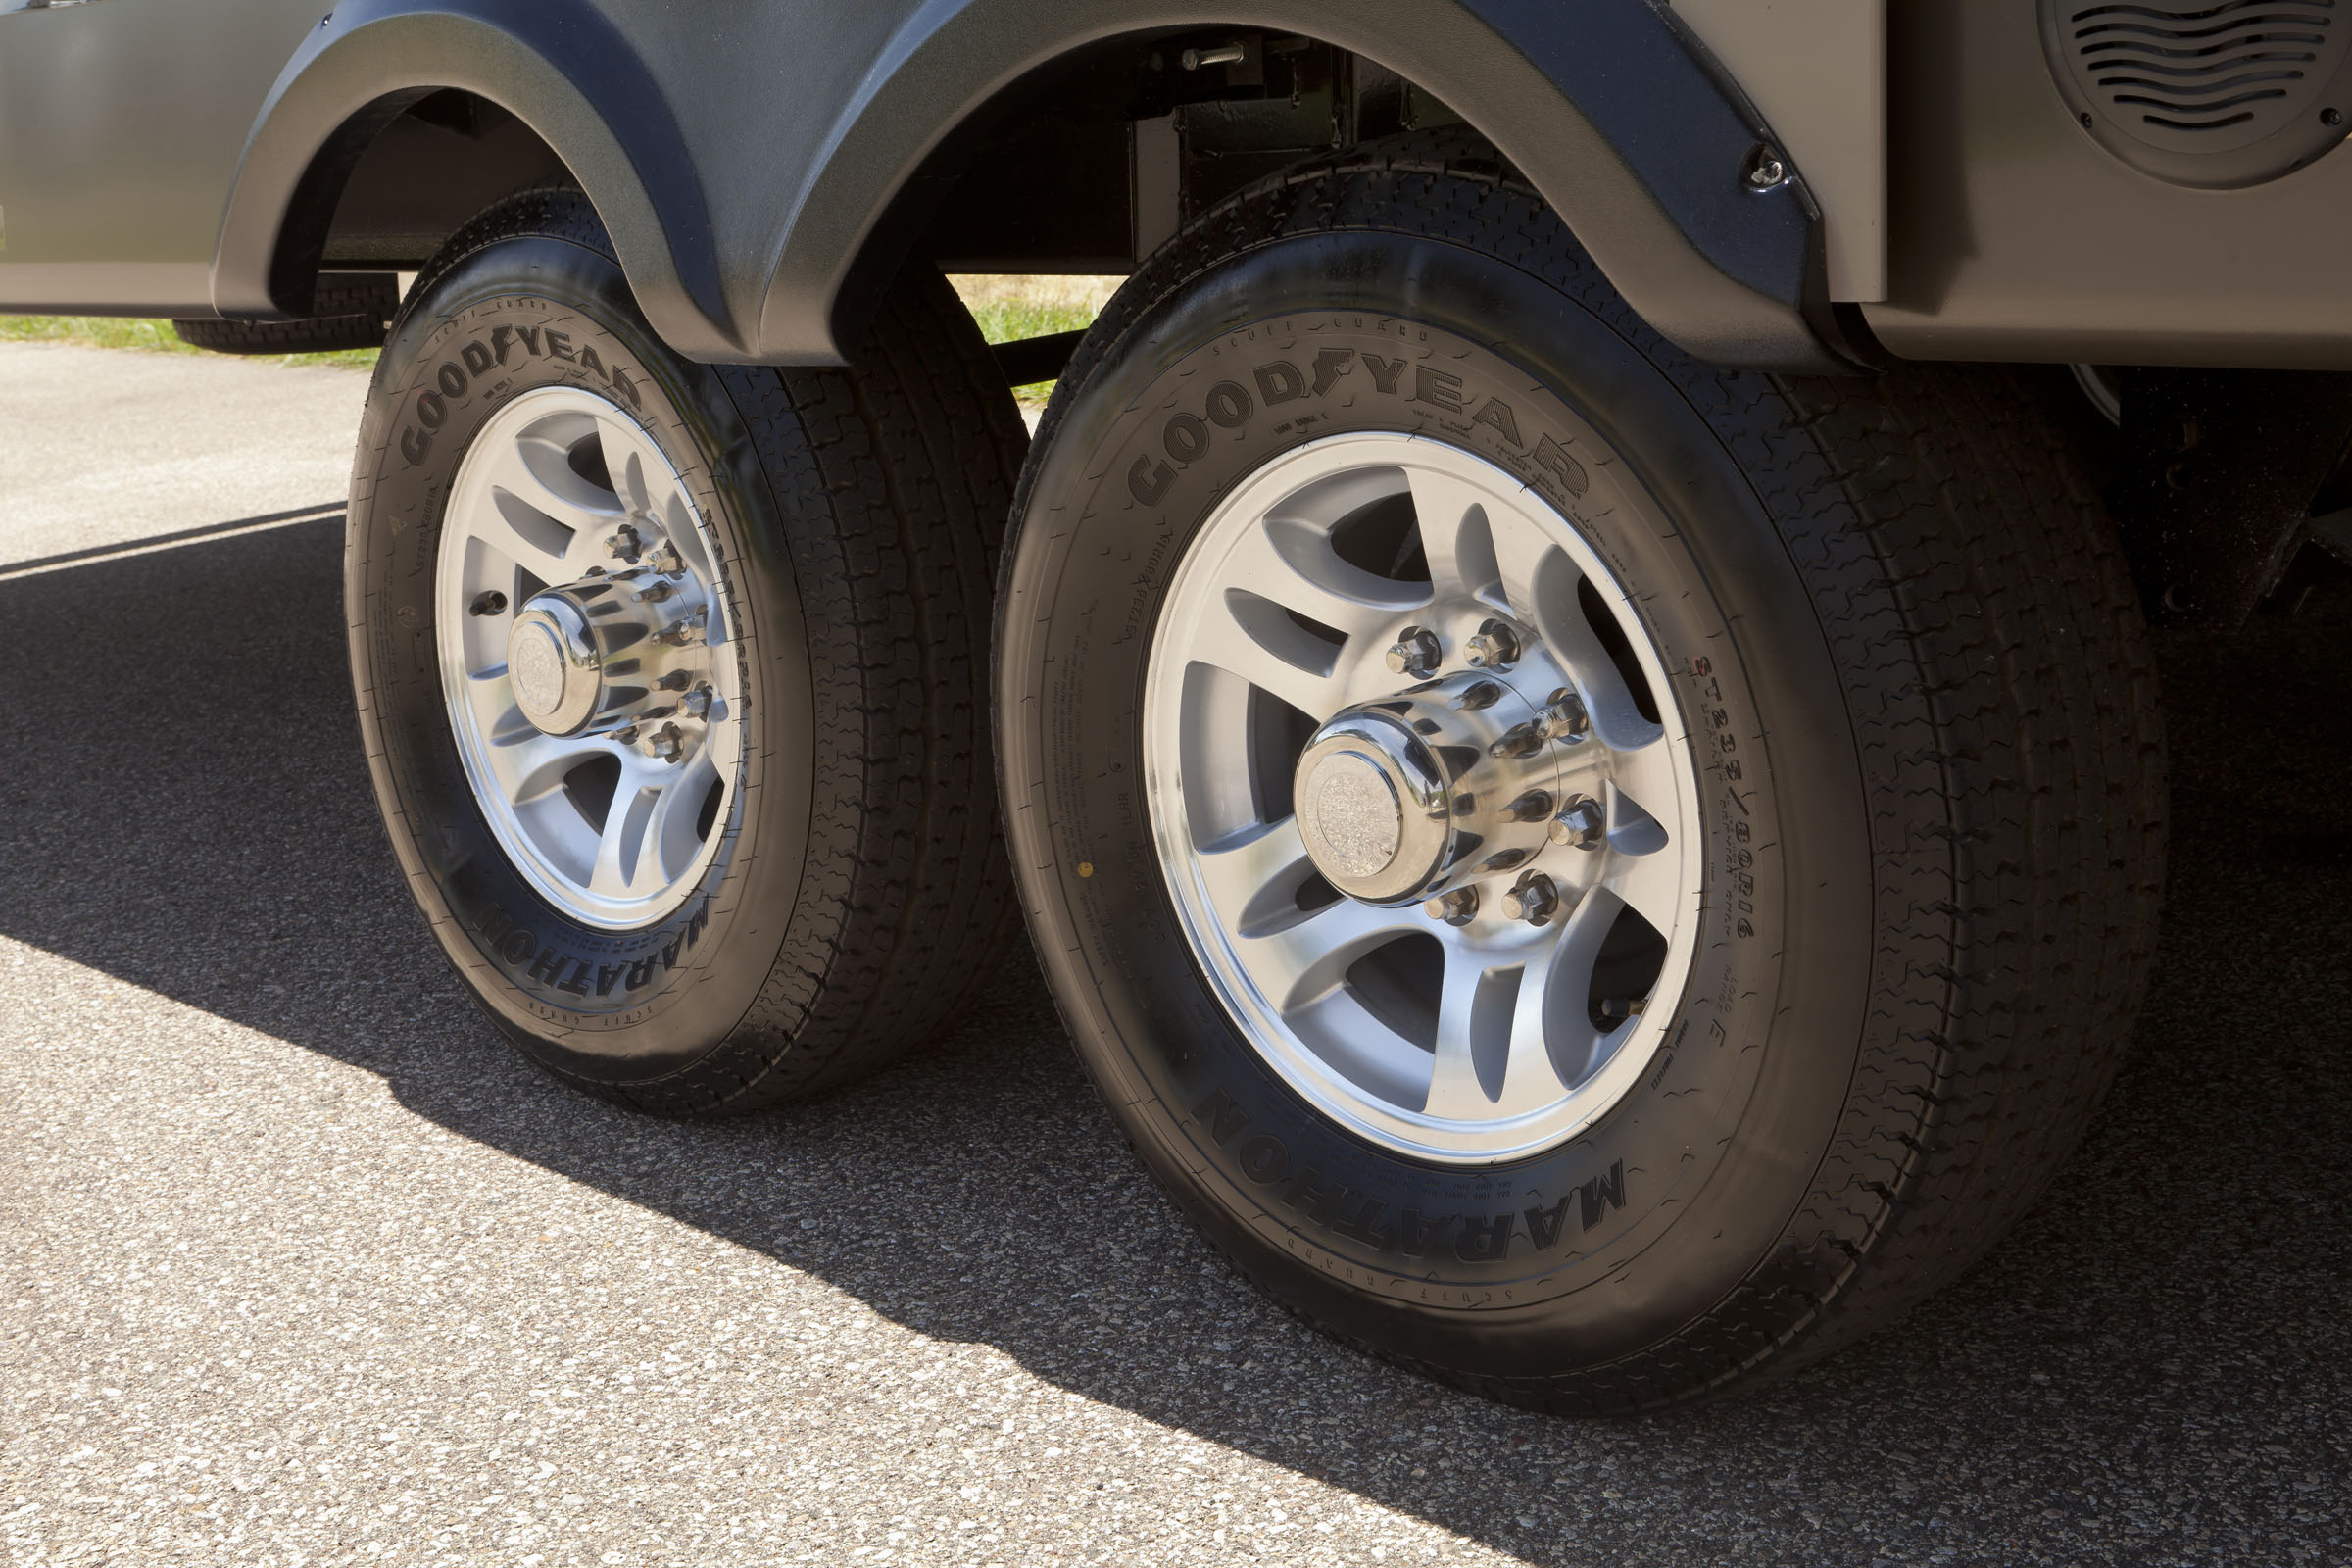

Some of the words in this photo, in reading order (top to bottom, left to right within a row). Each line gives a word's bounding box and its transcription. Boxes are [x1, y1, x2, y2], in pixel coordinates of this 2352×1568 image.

[400, 322, 643, 466] GOODYEAR
[1126, 347, 1592, 509] GOODYEAR
[1694, 656, 1755, 939] ST235/80R16
[472, 892, 710, 999] MARATHON
[1189, 1087, 1627, 1264] MARATHON
